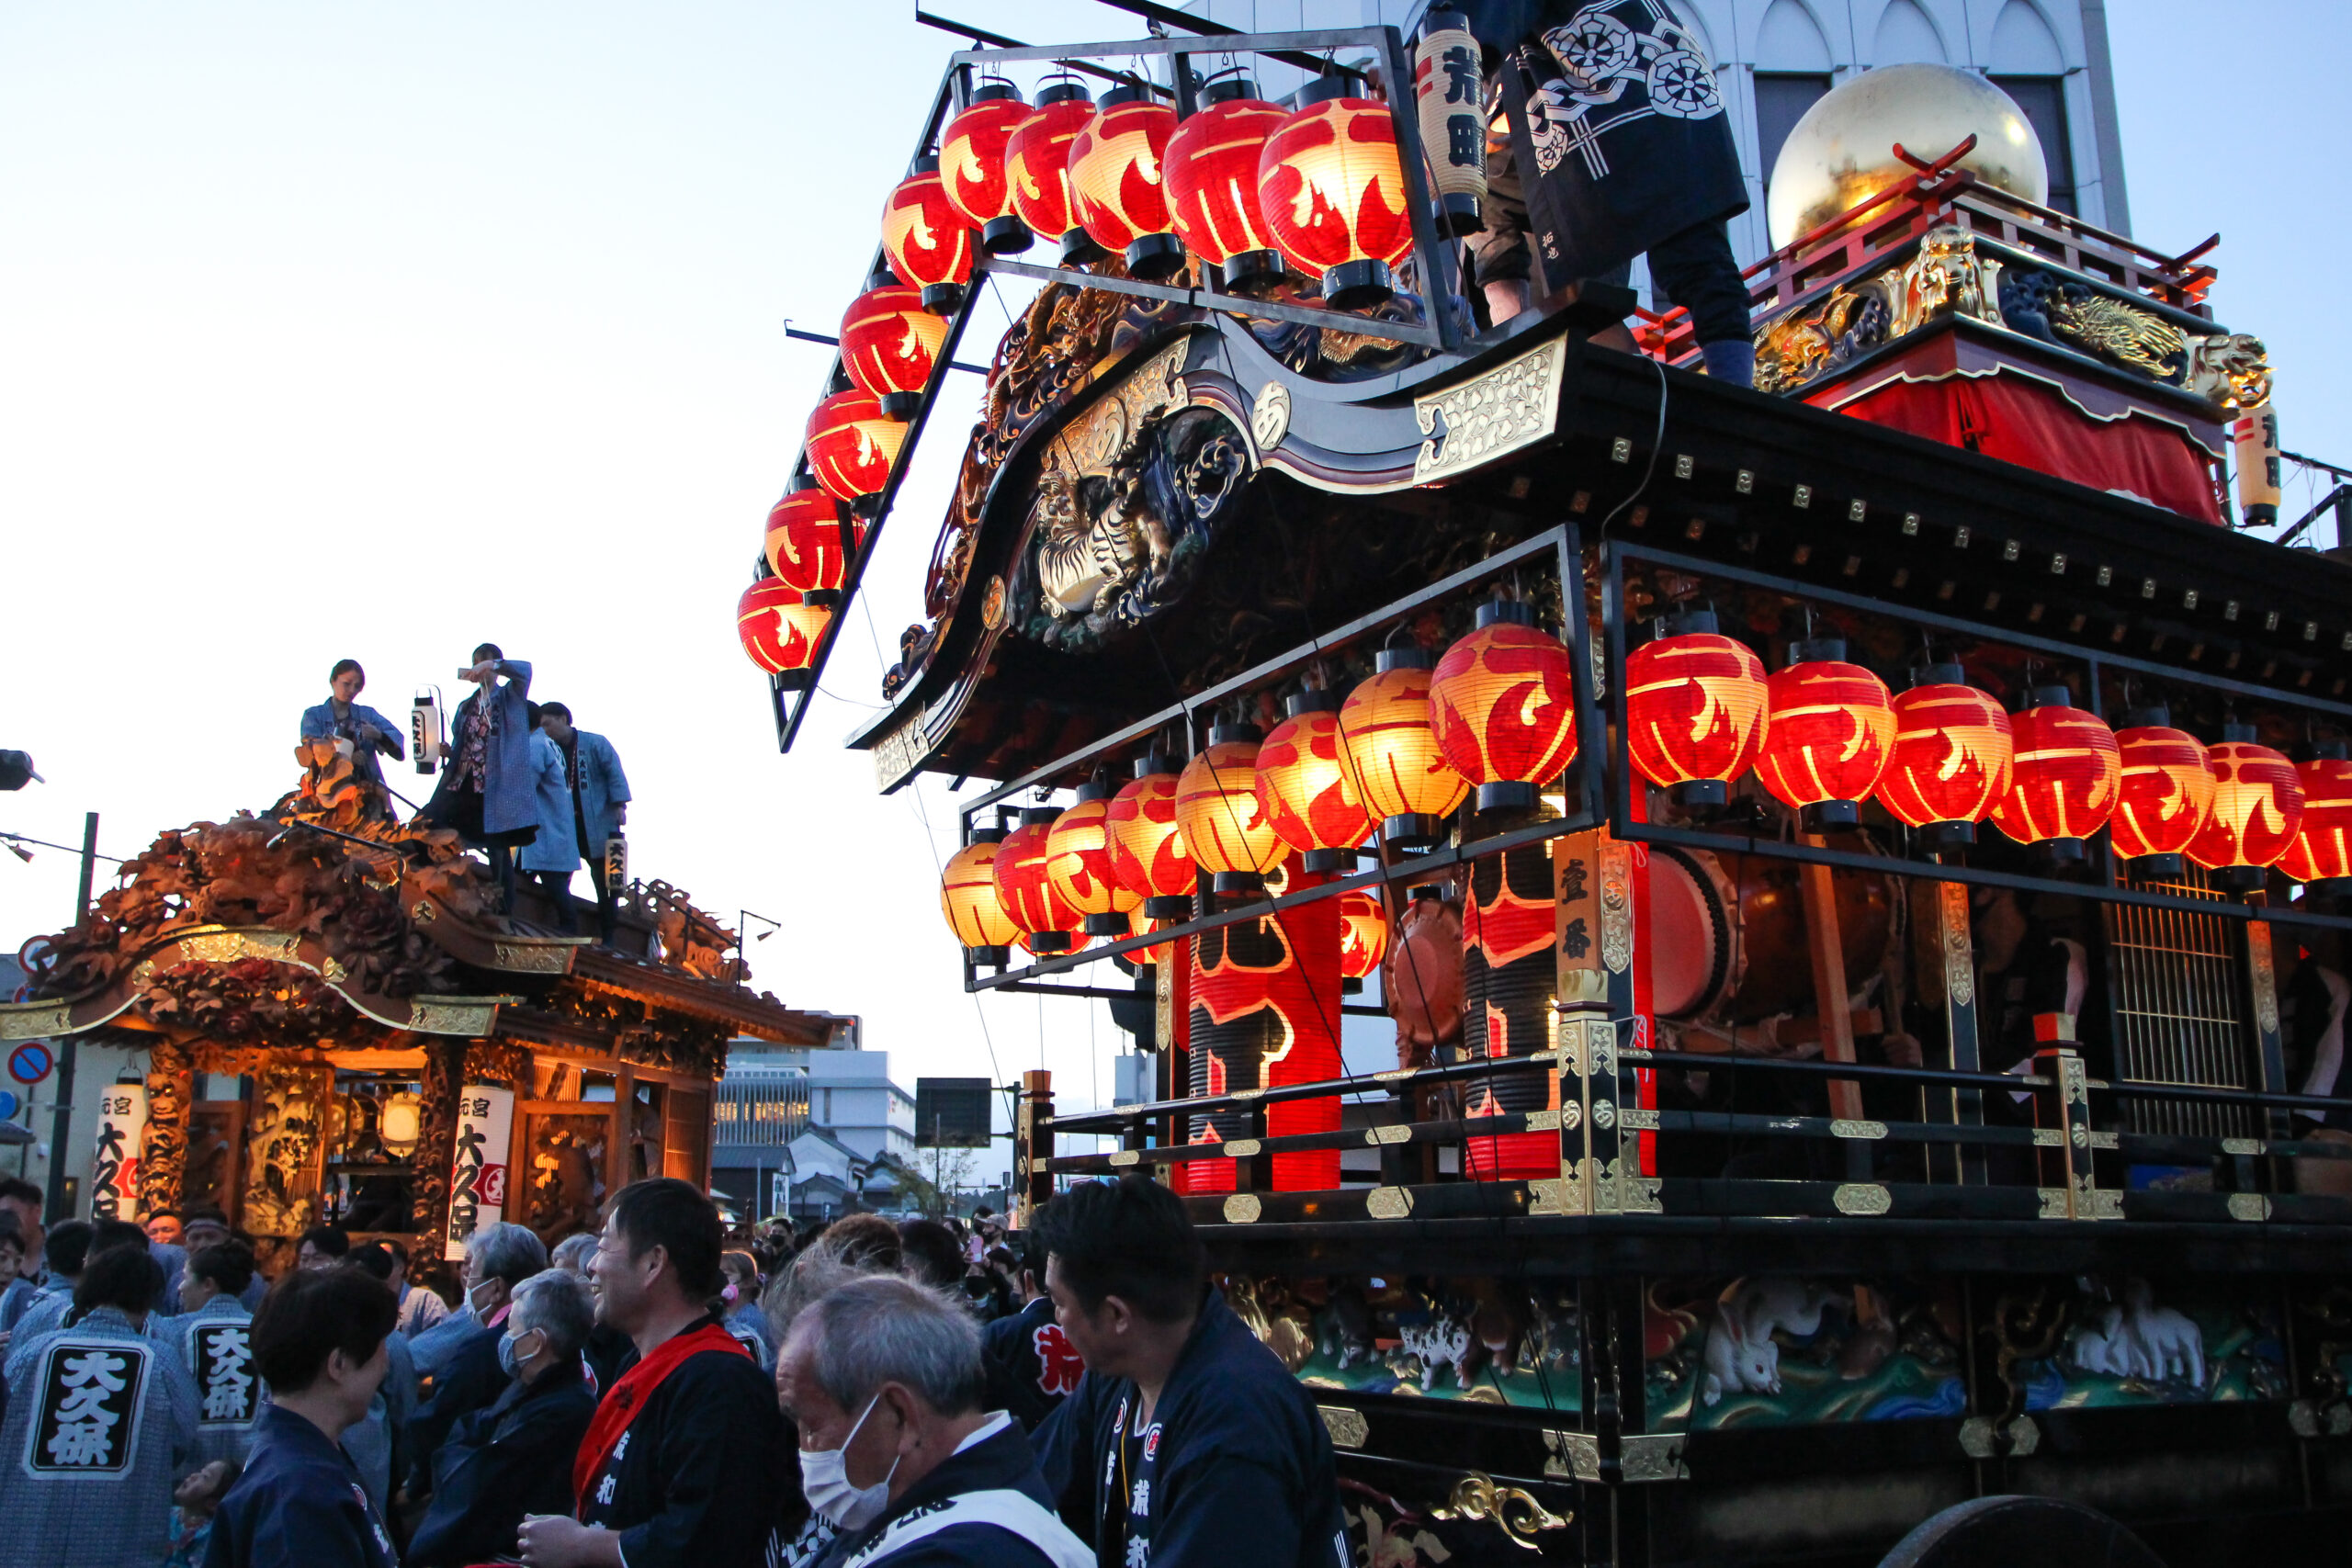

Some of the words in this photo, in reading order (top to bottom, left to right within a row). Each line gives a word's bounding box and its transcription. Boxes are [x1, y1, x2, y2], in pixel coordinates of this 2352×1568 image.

[609, 842, 624, 886] 大久保
[48, 1351, 127, 1465] 大久保
